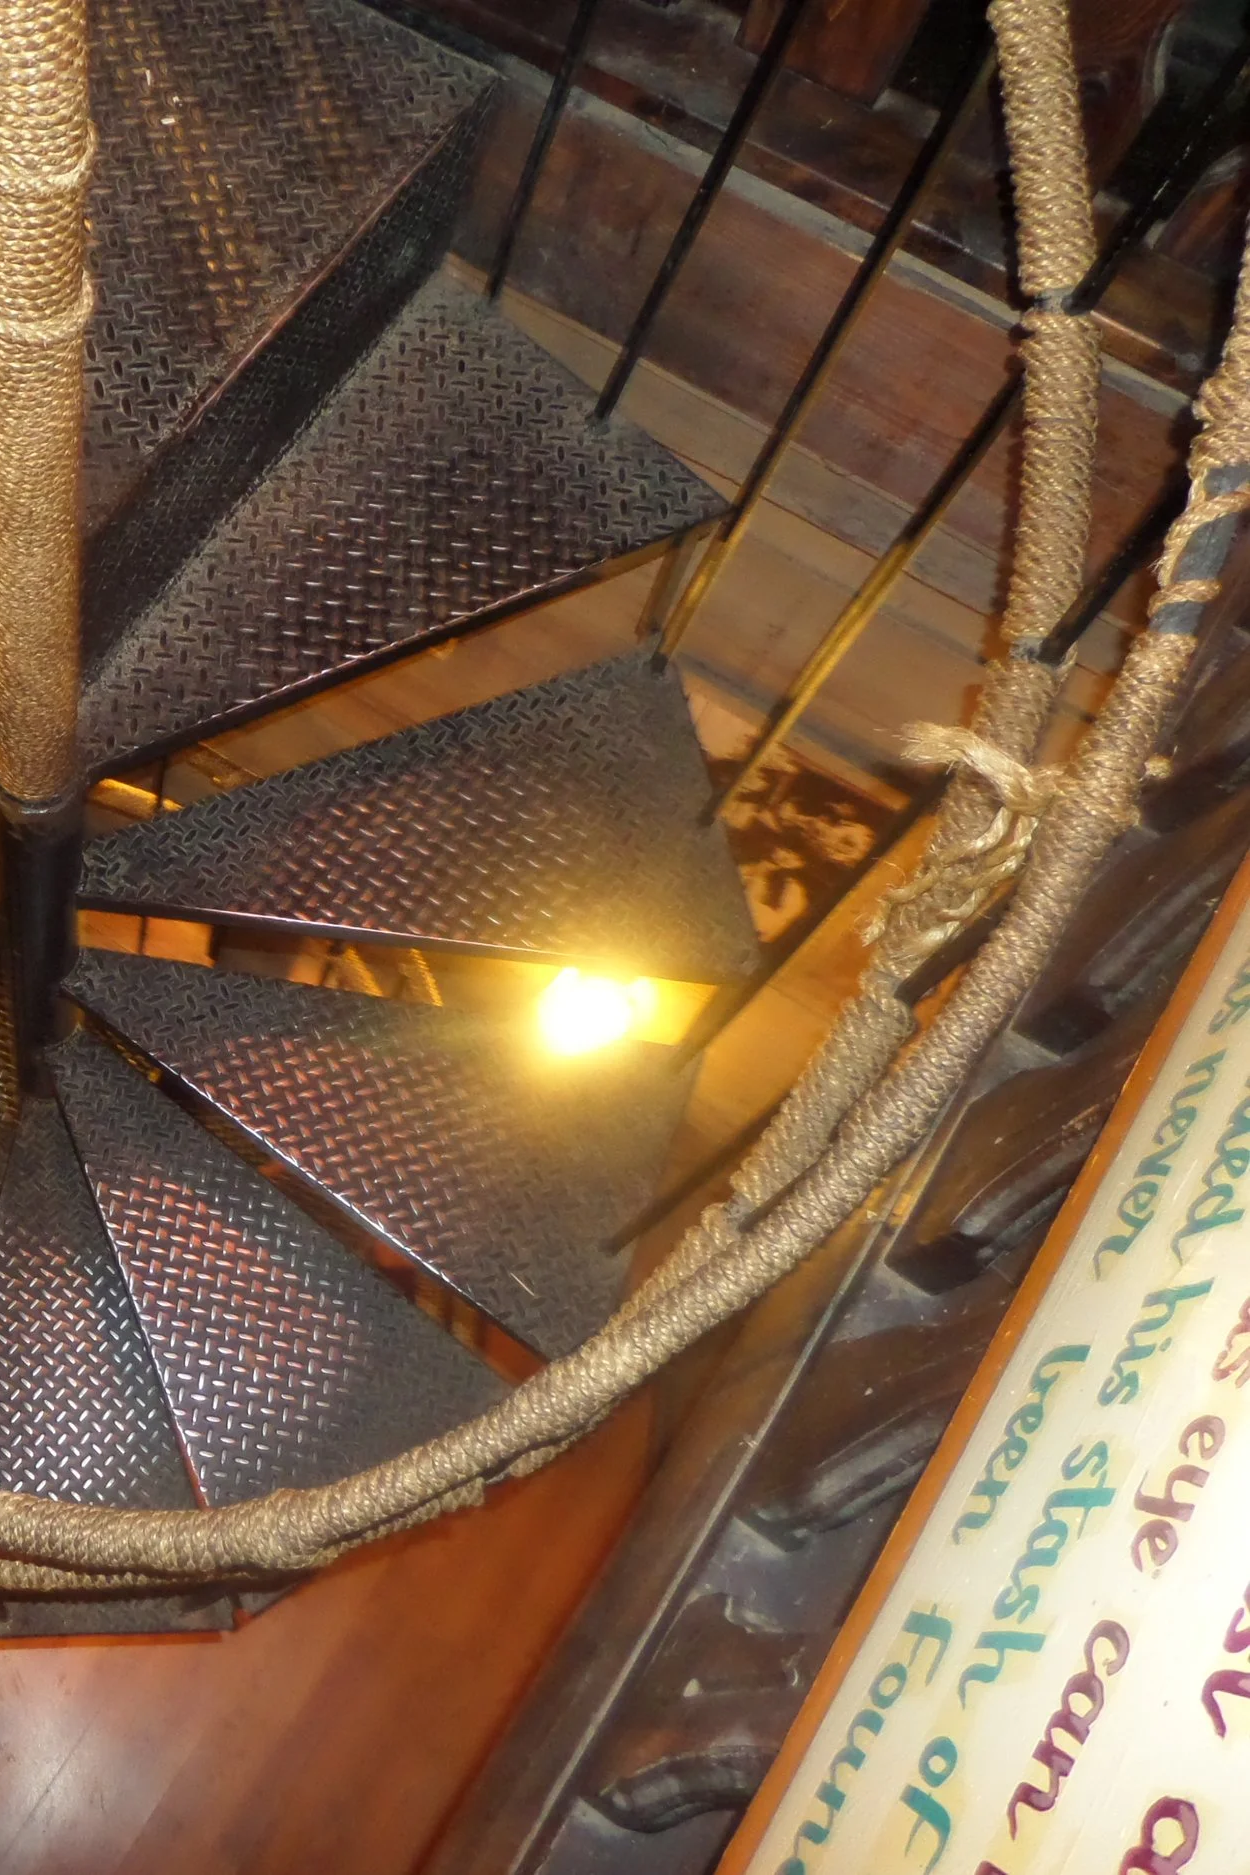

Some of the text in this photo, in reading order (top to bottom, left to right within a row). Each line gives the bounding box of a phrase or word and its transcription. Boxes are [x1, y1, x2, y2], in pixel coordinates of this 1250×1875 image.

[1092, 1048, 1227, 1281] never
[1097, 1277, 1216, 1407] his
[951, 1344, 1092, 1545] been
[1131, 1414, 1225, 1575] eye
[958, 1440, 1118, 1710] stash
[899, 1735, 959, 1875] of
[1007, 1620, 1131, 1842] can
